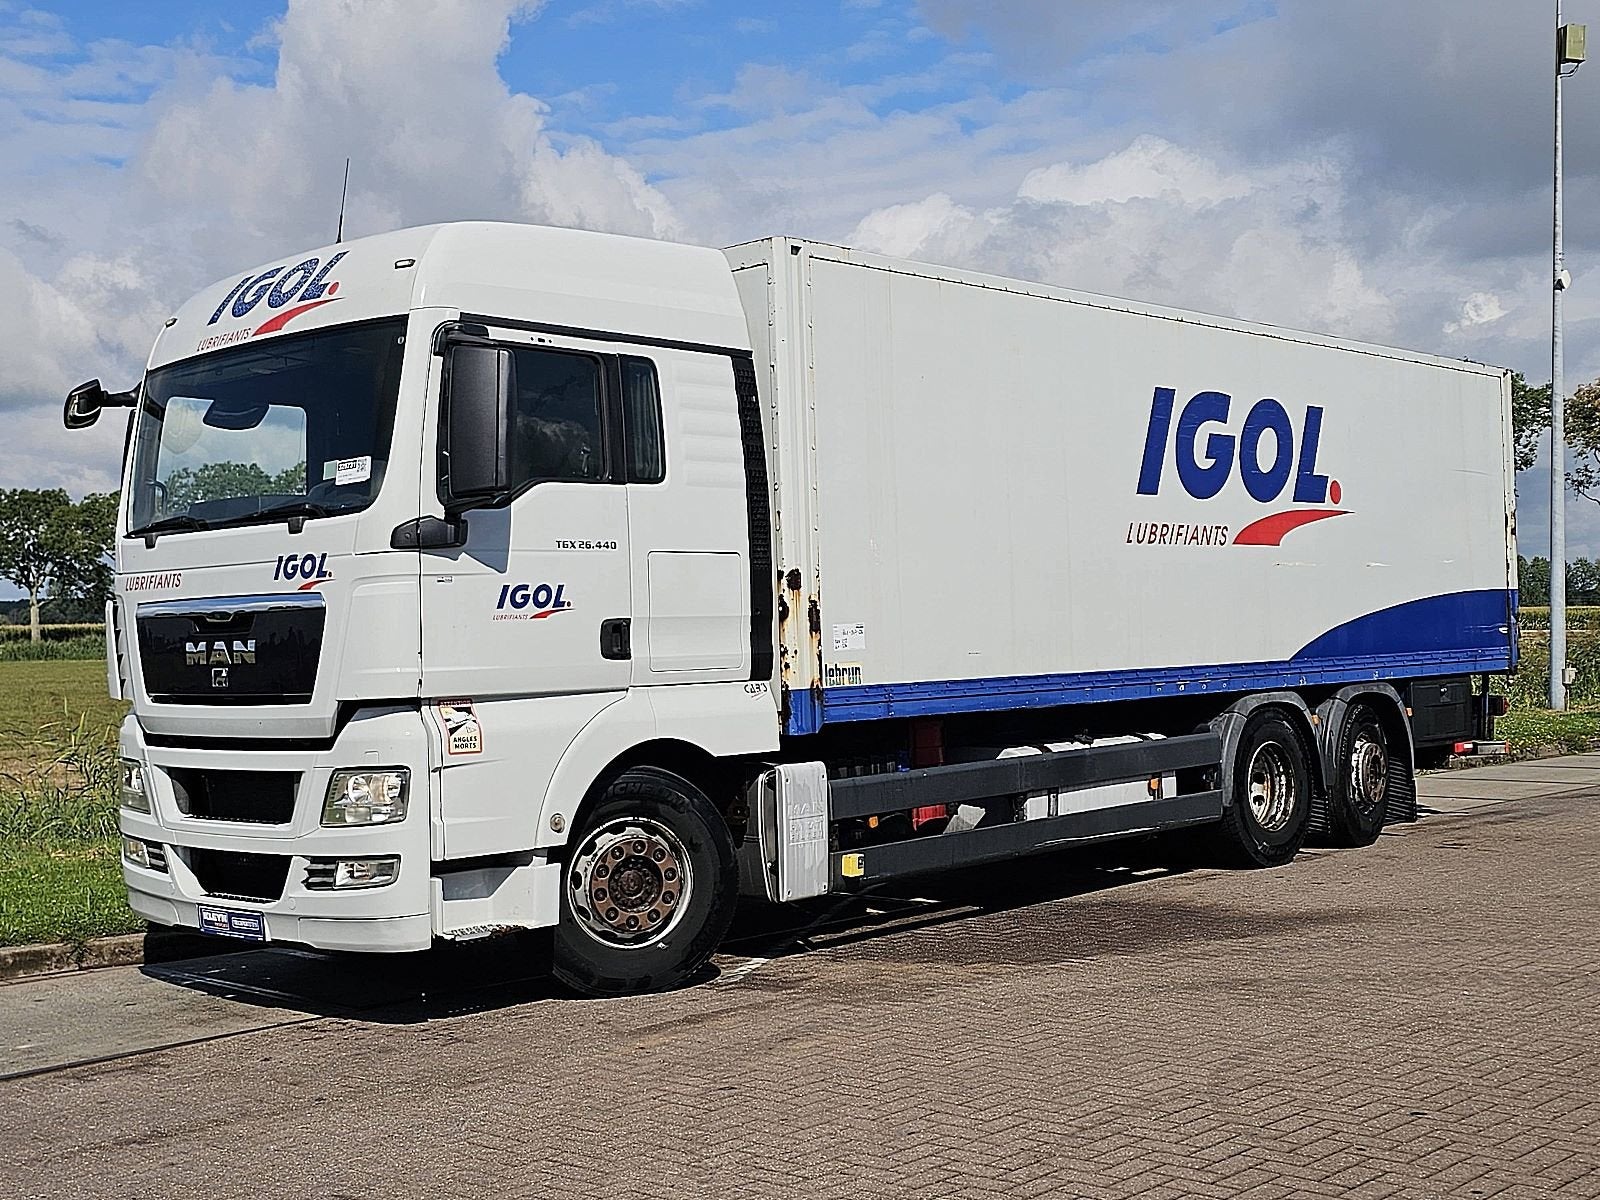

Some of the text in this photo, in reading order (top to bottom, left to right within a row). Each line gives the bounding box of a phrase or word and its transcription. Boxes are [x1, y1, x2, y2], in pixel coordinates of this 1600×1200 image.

[197, 327, 252, 352] LUBRIFIANTS
[1126, 522, 1229, 547] LUBRIFIANTS
[556, 540, 617, 550] TGX 26.440
[125, 573, 182, 592] LUBRIFIANTS
[185, 639, 256, 666] MAN
[825, 663, 861, 682] lebrun
[454, 742, 477, 750] MORTS
